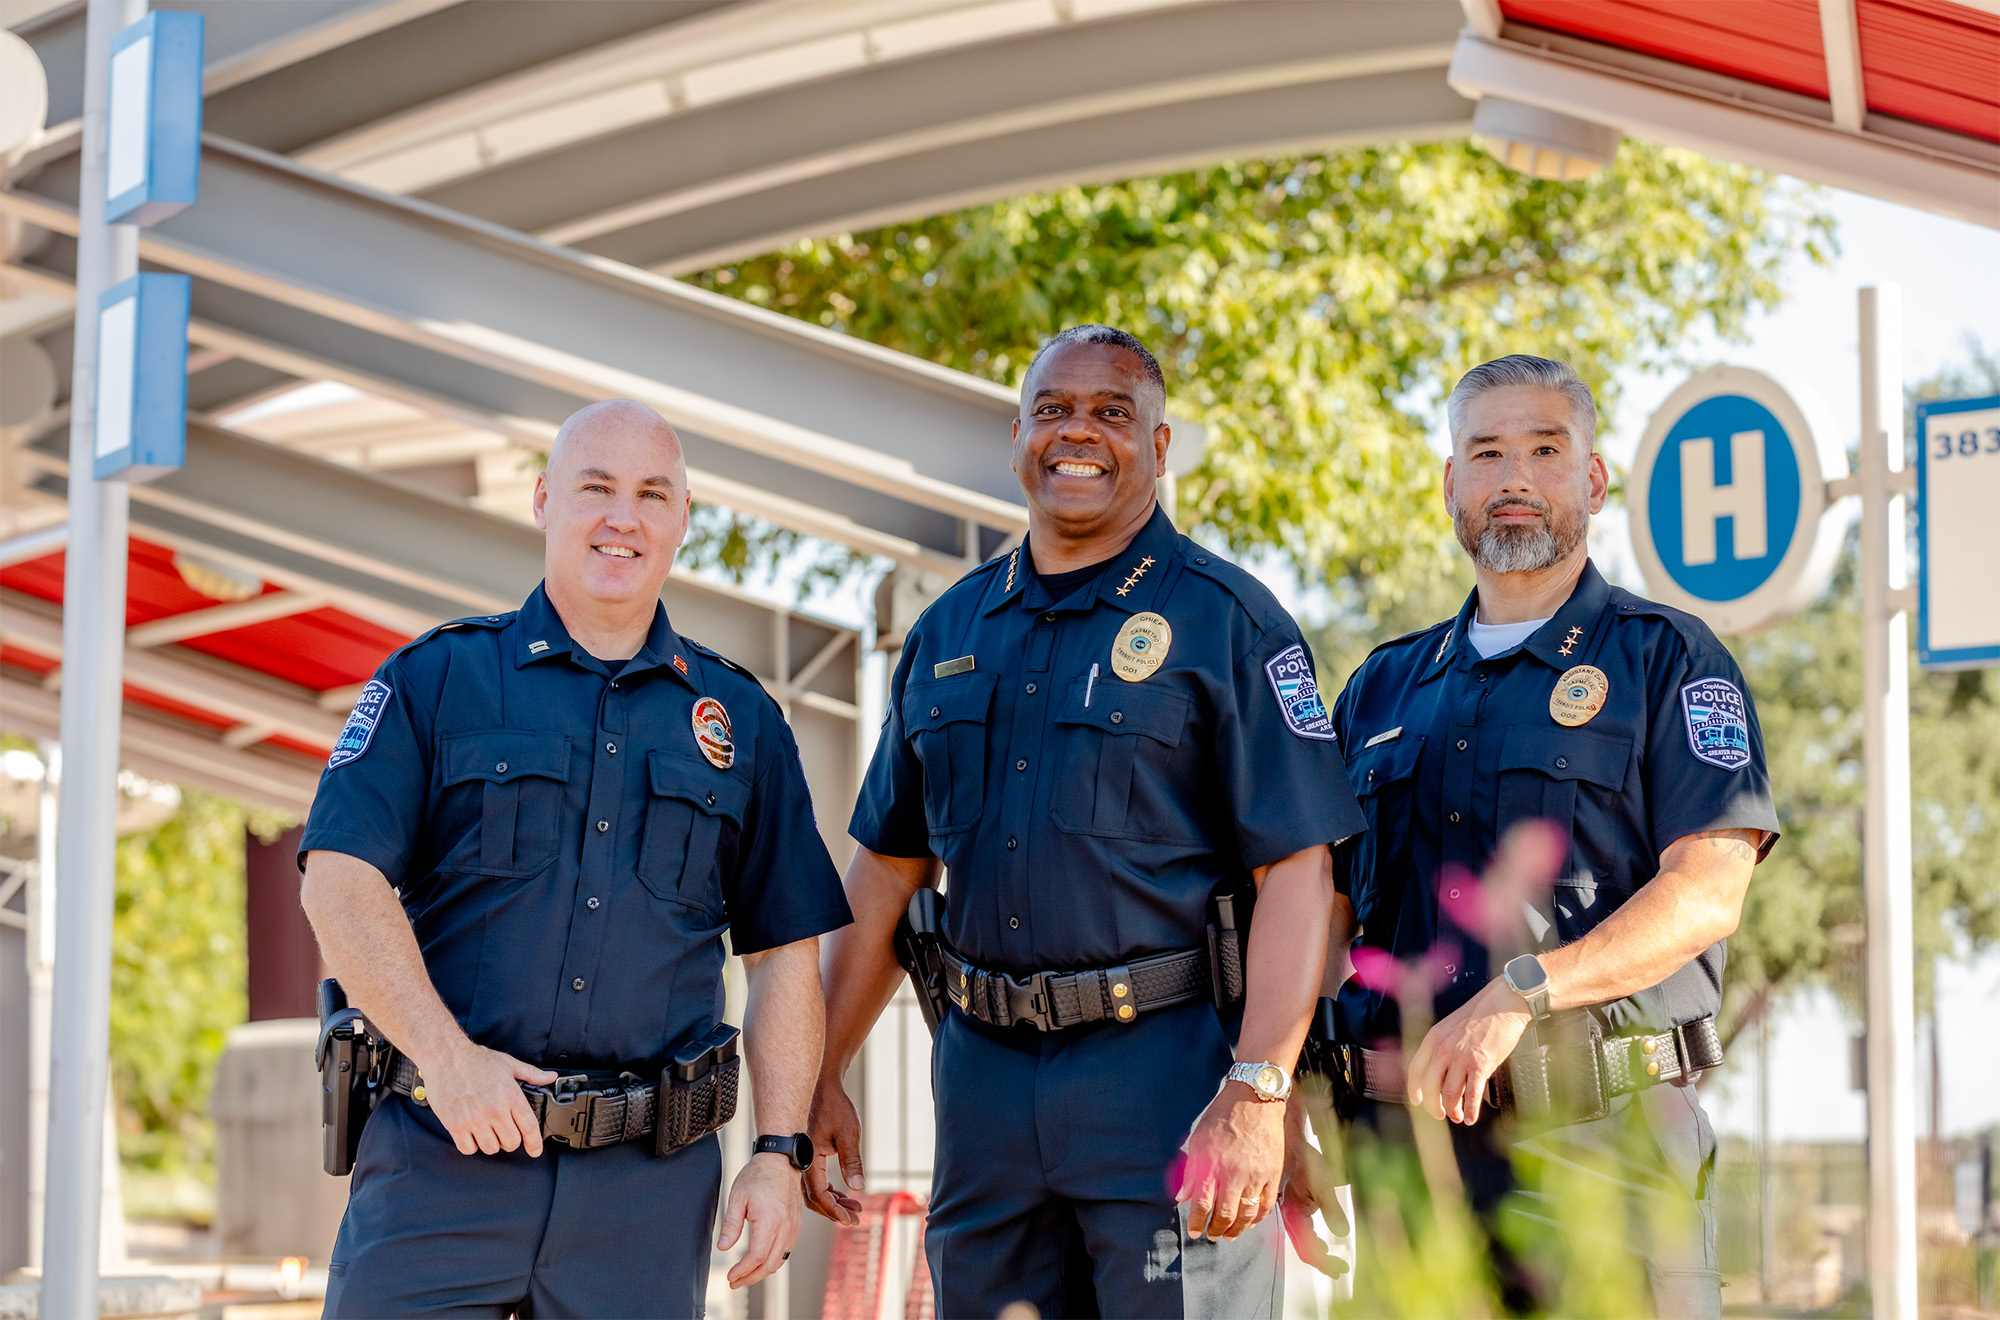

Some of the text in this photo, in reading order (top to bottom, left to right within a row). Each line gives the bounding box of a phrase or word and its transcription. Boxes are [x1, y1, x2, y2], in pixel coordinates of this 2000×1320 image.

[1934, 427, 2000, 459] 383
[1679, 429, 1768, 567] H
[1140, 616, 1163, 627] CHIEF
[1130, 628, 1159, 643] CAPMETRO
[1117, 648, 1156, 665] TRANSIT POLICE
[1122, 665, 1138, 674] 001
[1276, 658, 1309, 678] POL
[1563, 669, 1594, 682] ASSISTANT
[1702, 683, 1730, 691] CapMetro
[1555, 698, 1574, 709] TRANSIT
[1691, 690, 1741, 706] POLICE
[1560, 711, 1577, 720] 002
[1320, 723, 1333, 732] ARE
